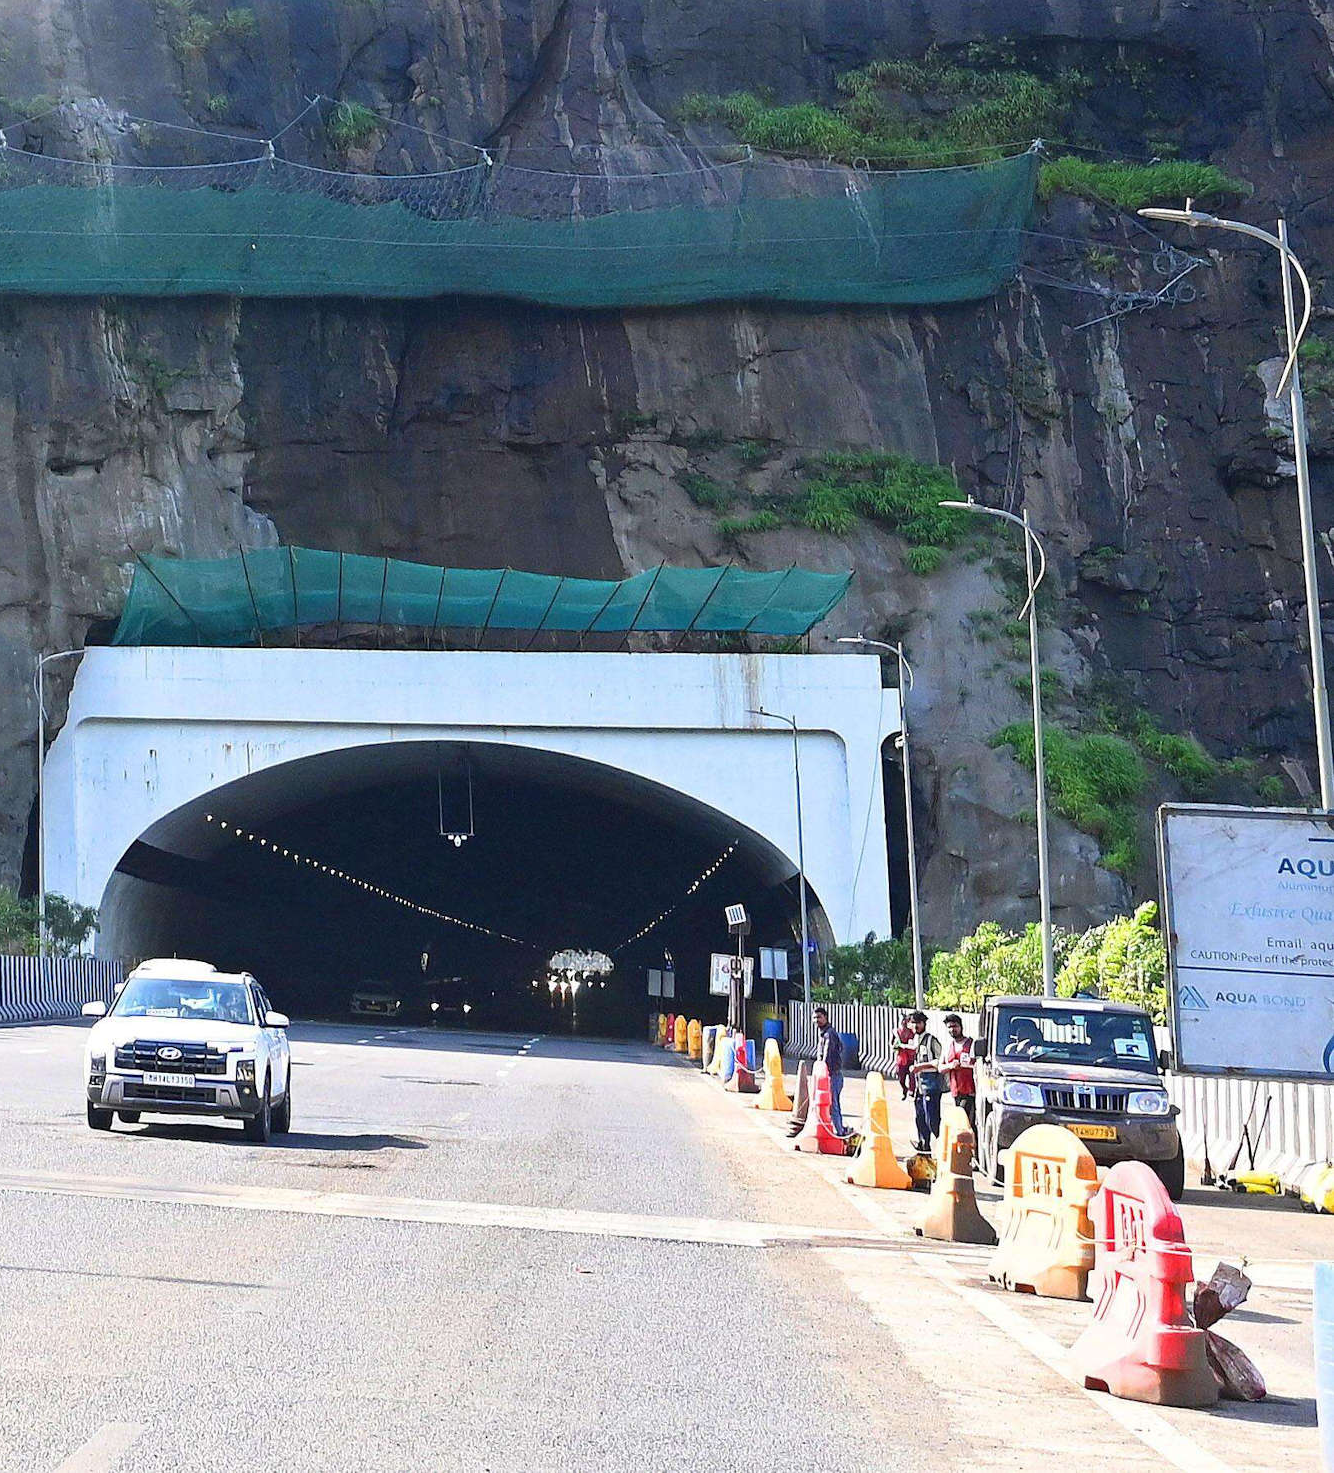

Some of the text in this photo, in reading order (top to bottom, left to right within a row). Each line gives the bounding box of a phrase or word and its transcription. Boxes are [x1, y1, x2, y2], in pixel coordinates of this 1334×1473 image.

[1277, 858, 1334, 879] AQU
[1265, 955, 1279, 964] off
[1216, 992, 1306, 1007] AQUA BOND
